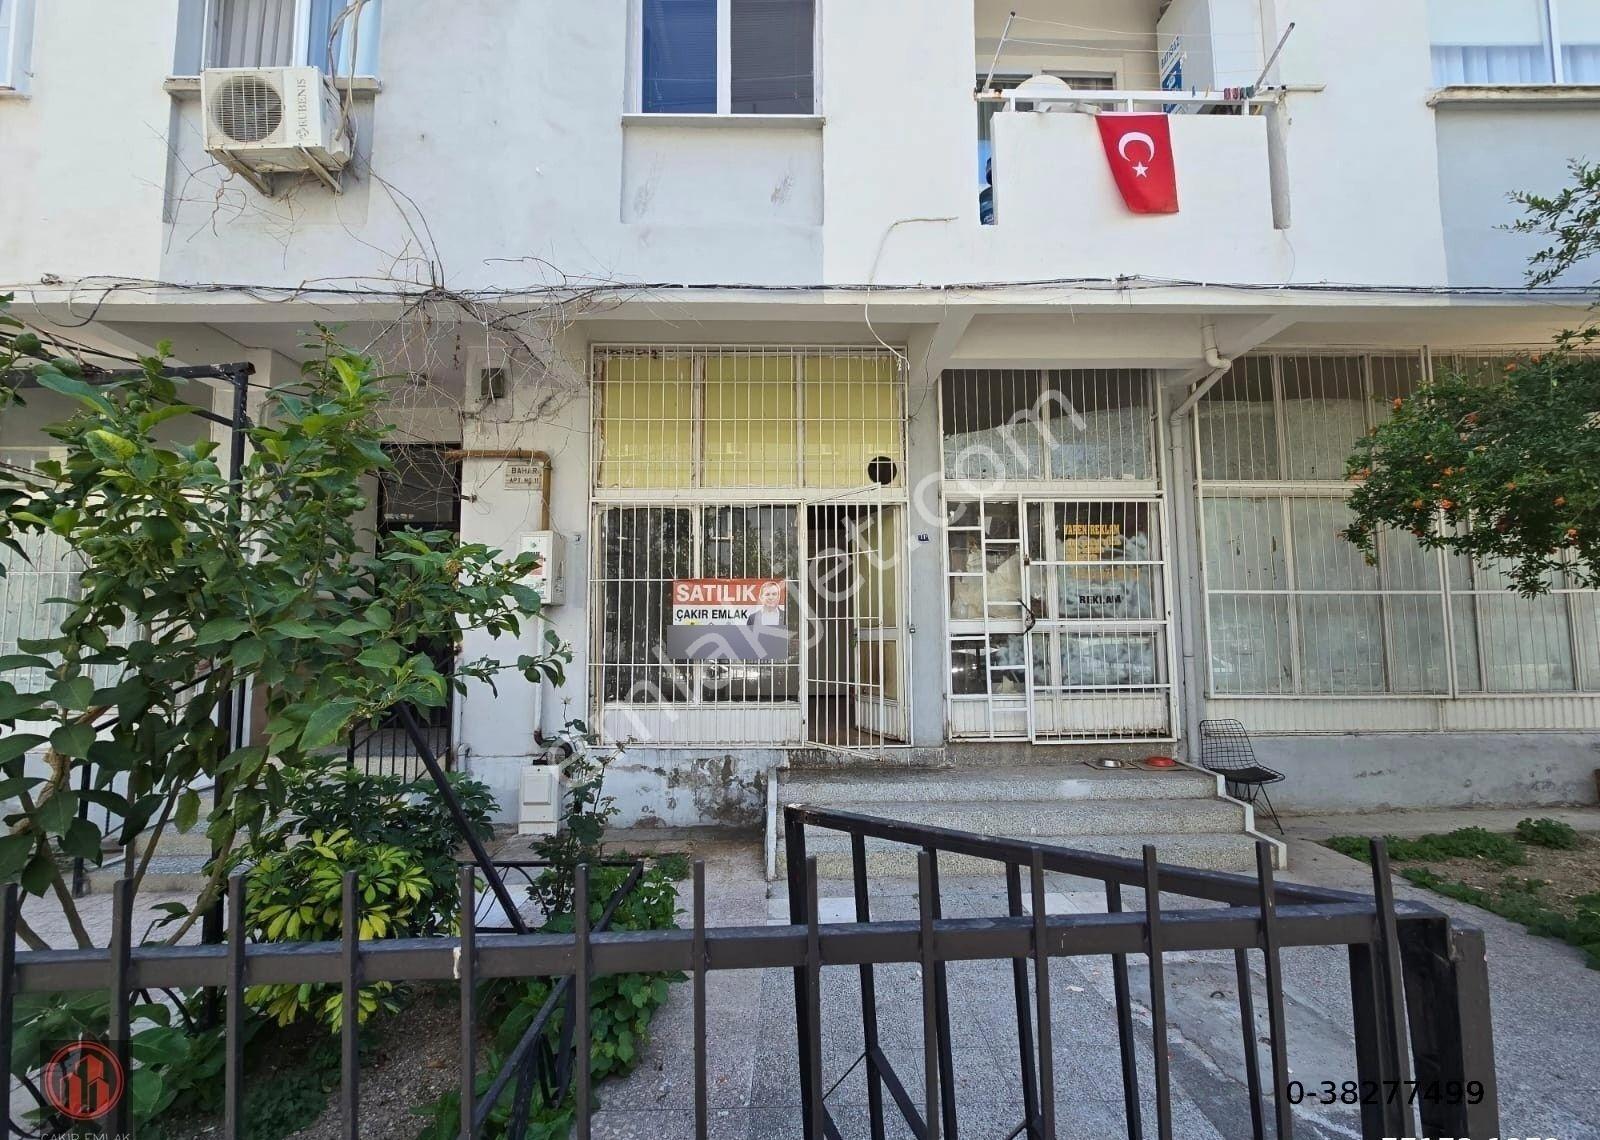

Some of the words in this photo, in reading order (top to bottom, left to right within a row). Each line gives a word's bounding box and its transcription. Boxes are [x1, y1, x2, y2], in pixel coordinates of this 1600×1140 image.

[511, 466, 539, 475] BAHAR
[676, 583, 757, 602] SATILIK
[676, 609, 709, 622] ÇAKIR
[711, 609, 748, 620] EMLAK
